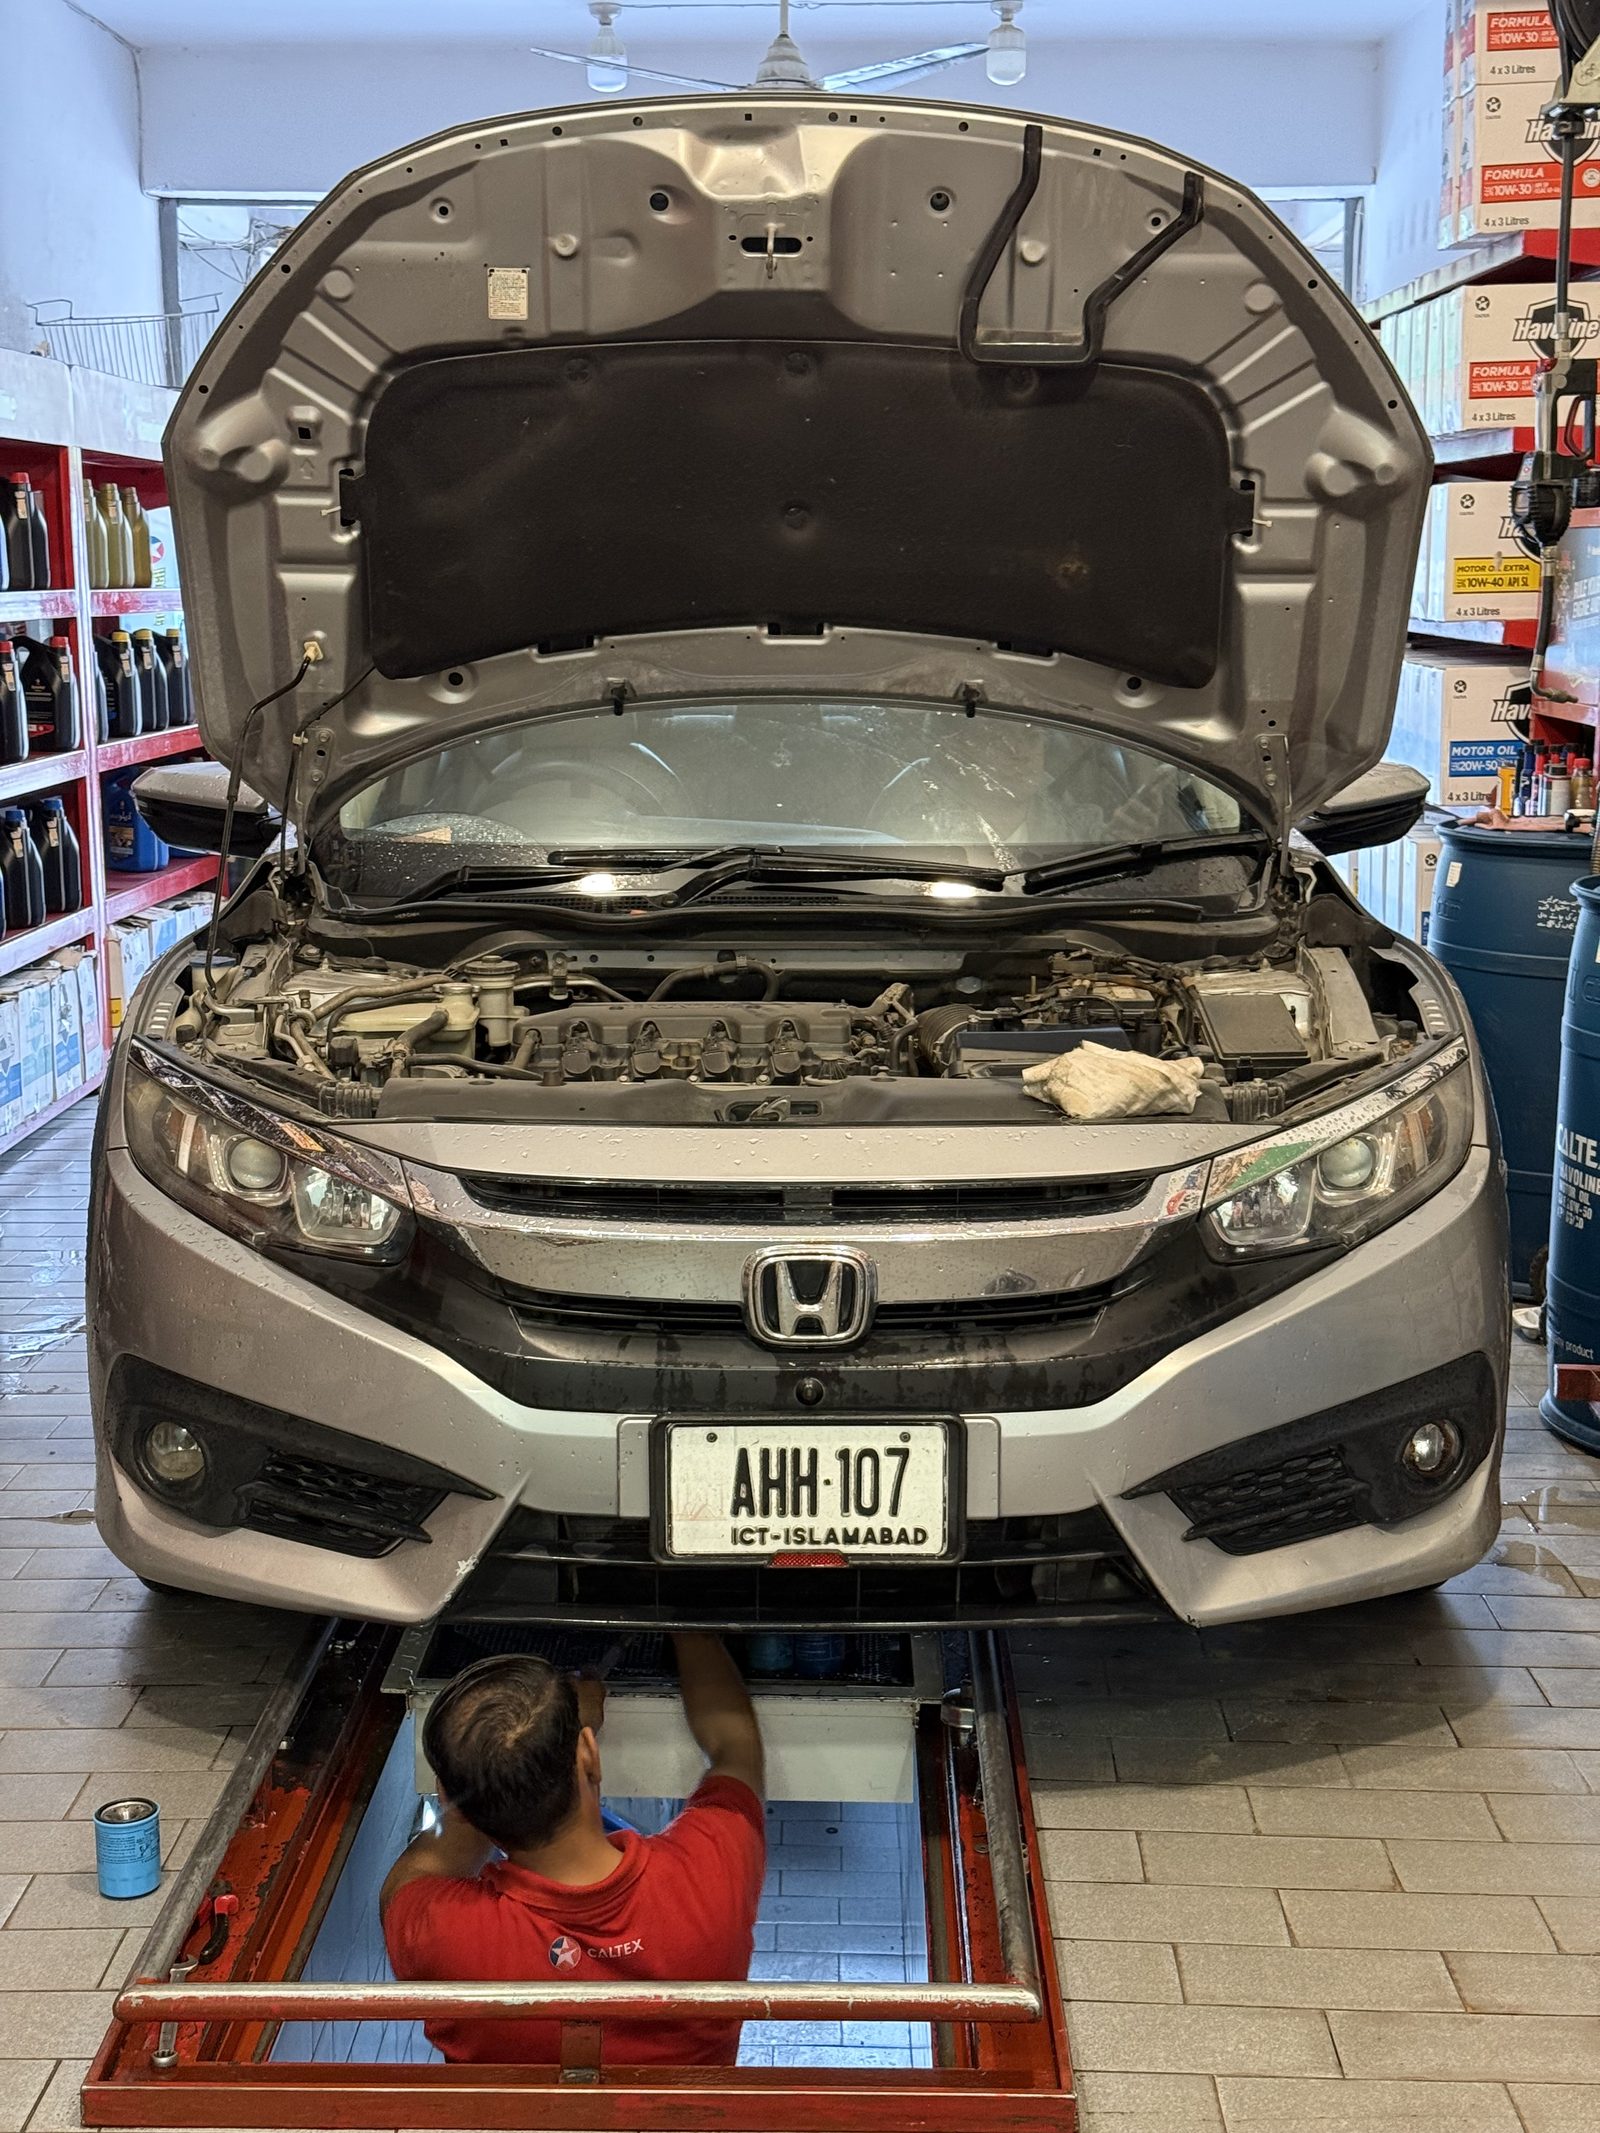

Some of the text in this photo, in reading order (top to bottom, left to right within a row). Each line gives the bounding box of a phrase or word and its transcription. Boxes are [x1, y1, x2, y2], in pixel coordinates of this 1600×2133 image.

[1490, 15, 1551, 28] FORMULA
[1500, 31, 1539, 44] 10W-30
[1490, 64, 1536, 75] 4 x 3 Litres
[1484, 168, 1544, 180] FORMULA
[1494, 183, 1532, 196] 10W-30
[1484, 216, 1530, 227] 4 x 3 Litres
[1512, 318, 1599, 341] Havine
[1472, 366, 1531, 377] FORMULA
[1481, 380, 1519, 392] 10W-30
[1472, 413, 1478, 421] 4
[1485, 412, 1491, 421] 3
[1492, 412, 1517, 421] Litres
[1457, 565, 1486, 573] MOTOR
[1503, 564, 1530, 572] EXTRA
[1467, 577, 1504, 588] 10W-40
[1508, 576, 1520, 587] API
[1456, 607, 1462, 616] 4
[1469, 607, 1476, 616] 3
[1476, 606, 1500, 616] Litres
[1451, 745, 1517, 757] MOTOR OIL
[1458, 760, 1498, 771] 20W-50
[1448, 791, 1454, 801] 4
[1462, 791, 1469, 801] 3
[1557, 1123, 1600, 1170] CALTE
[1565, 1341, 1594, 1360] product
[731, 1526, 929, 1546] ICT-ISLAMABAD
[587, 1938, 645, 1958] CALTEX
